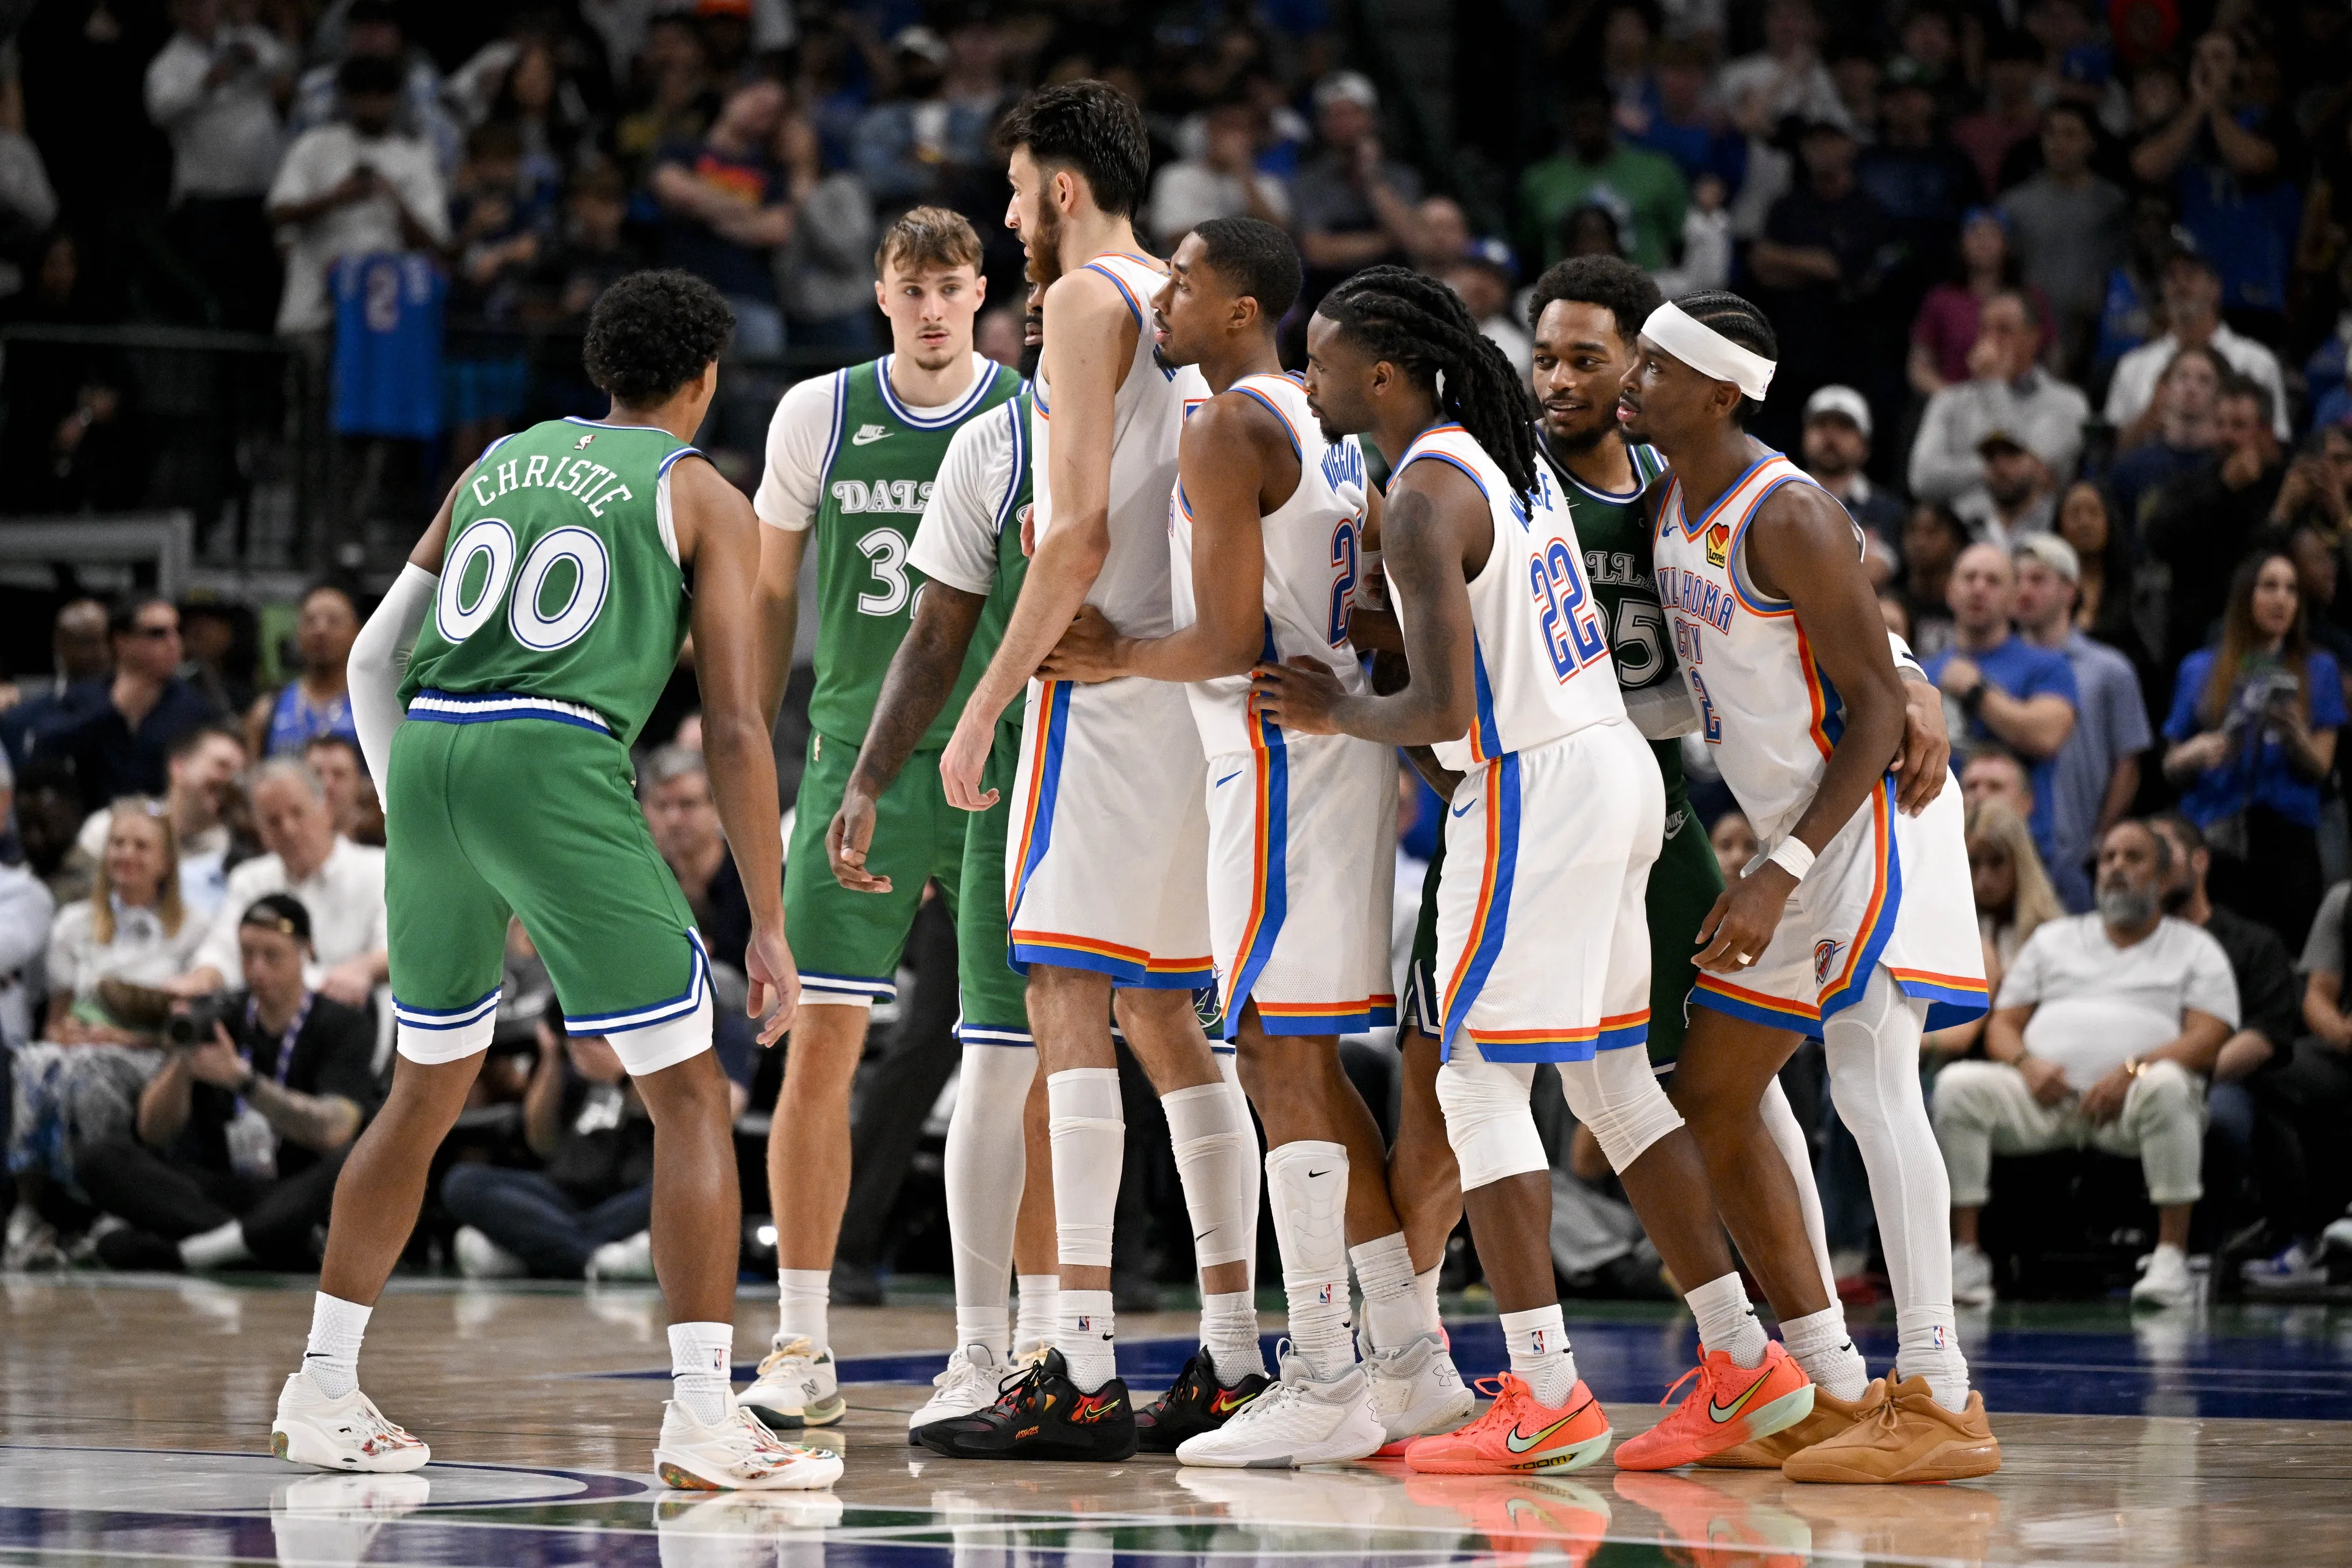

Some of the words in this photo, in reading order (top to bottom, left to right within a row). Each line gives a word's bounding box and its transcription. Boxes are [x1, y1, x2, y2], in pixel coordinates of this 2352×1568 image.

[859, 424, 886, 437] NIKE
[1321, 441, 1363, 495] WIGGINS
[472, 455, 633, 518] CHRISTIE
[435, 517, 610, 652] 00
[856, 527, 927, 620] 3
[1529, 537, 1610, 686] 22
[1594, 597, 1665, 687] 5
[1688, 666, 1722, 745] 2
